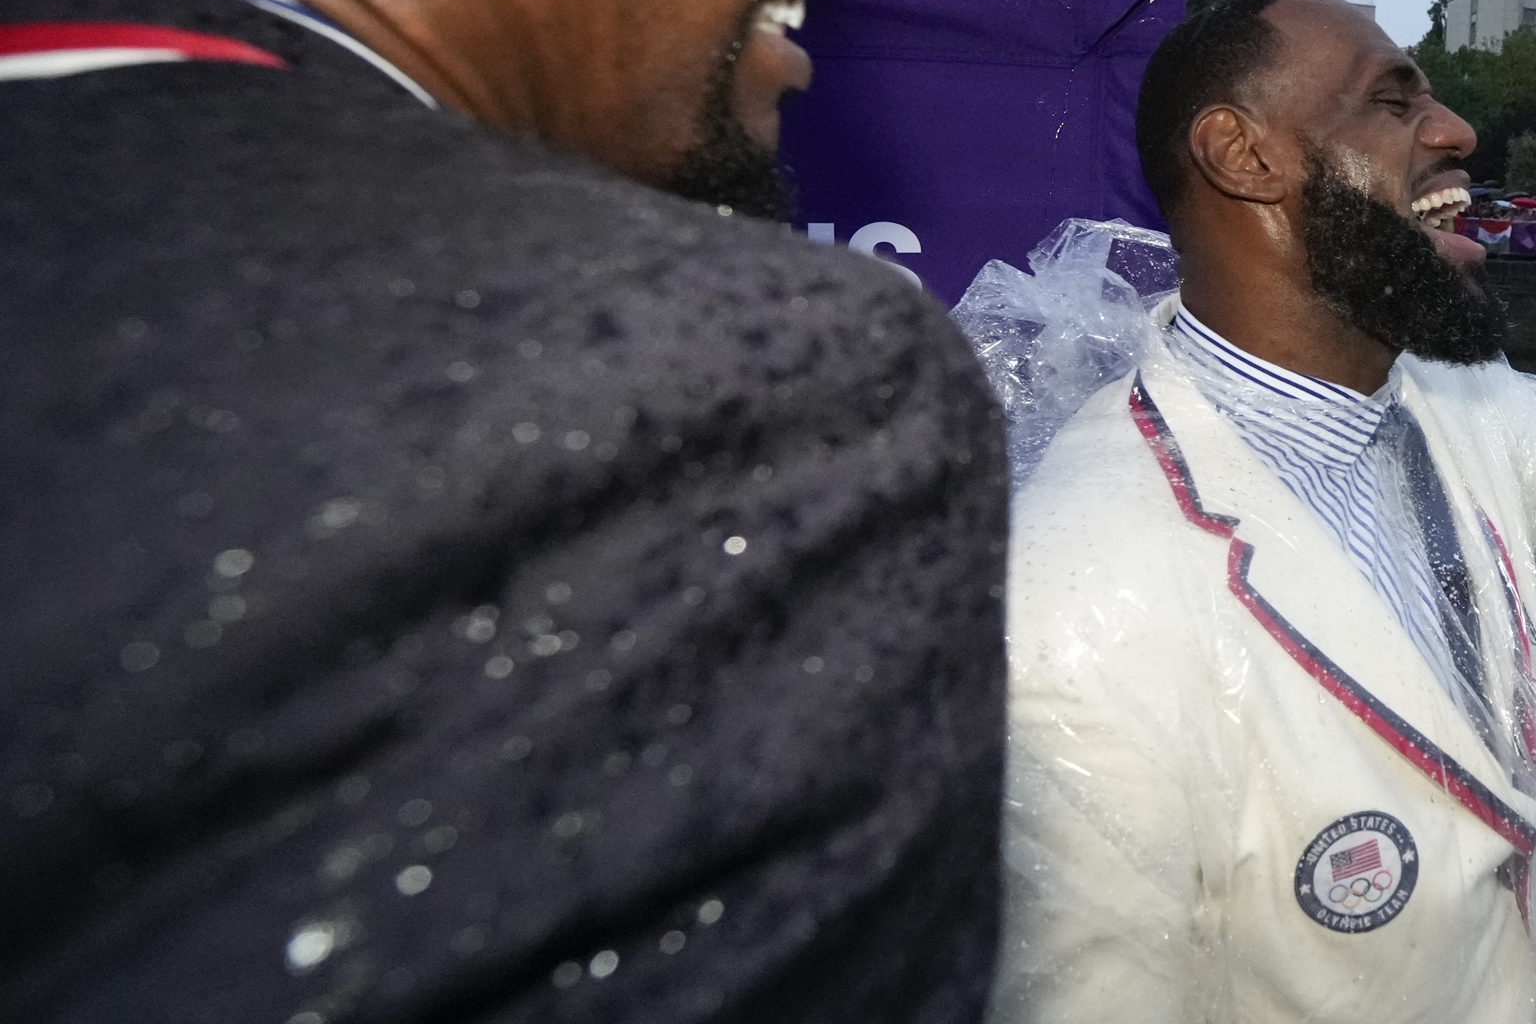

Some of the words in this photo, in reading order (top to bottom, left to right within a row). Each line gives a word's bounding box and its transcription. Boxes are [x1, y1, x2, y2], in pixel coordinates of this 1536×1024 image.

[1306, 824, 1347, 863] UNITED
[1349, 816, 1397, 835] STATES
[1316, 908, 1372, 930] OLYMPIC
[1379, 889, 1409, 920] TEAM
